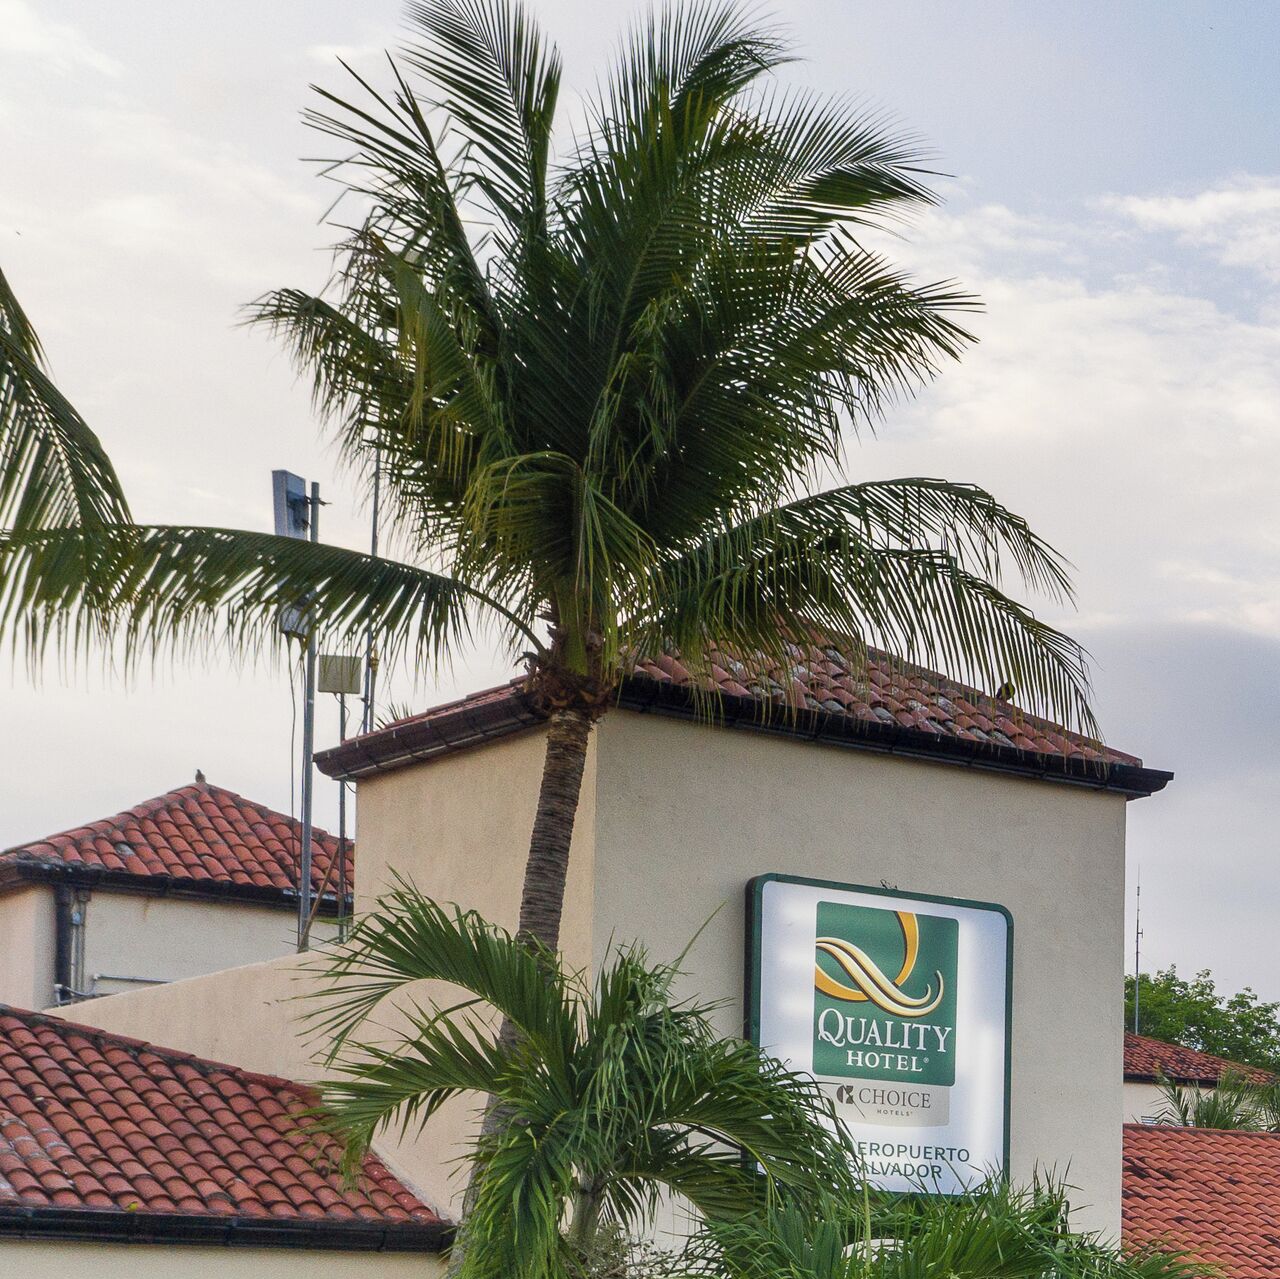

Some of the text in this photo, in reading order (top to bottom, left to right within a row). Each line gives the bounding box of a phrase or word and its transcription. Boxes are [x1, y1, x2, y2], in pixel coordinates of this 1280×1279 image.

[818, 1008, 952, 1052] QUALITY
[859, 1088, 931, 1108] CHOICE
[857, 1141, 970, 1162] EROPUERTO
